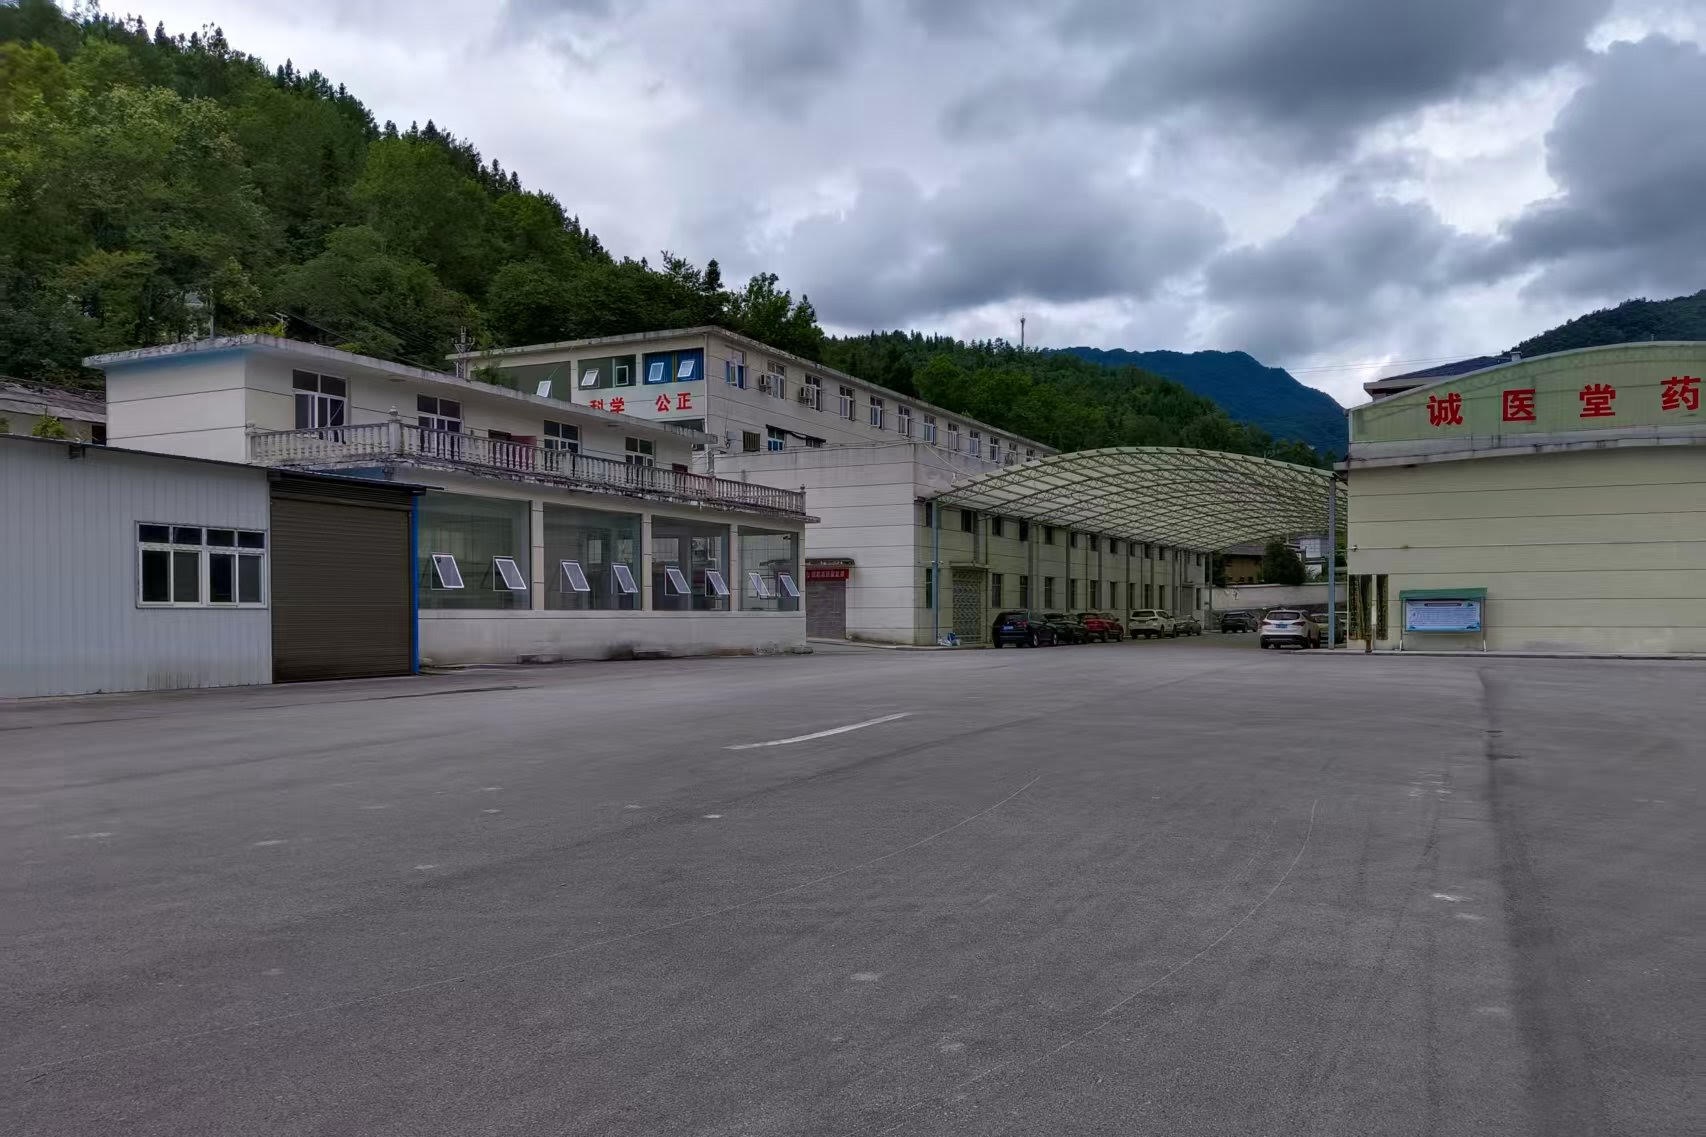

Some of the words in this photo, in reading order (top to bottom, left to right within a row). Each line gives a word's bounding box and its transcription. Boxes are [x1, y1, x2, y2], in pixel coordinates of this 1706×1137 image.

[655, 392, 693, 412] 公正
[1426, 375, 1702, 427] 诚医堂药
